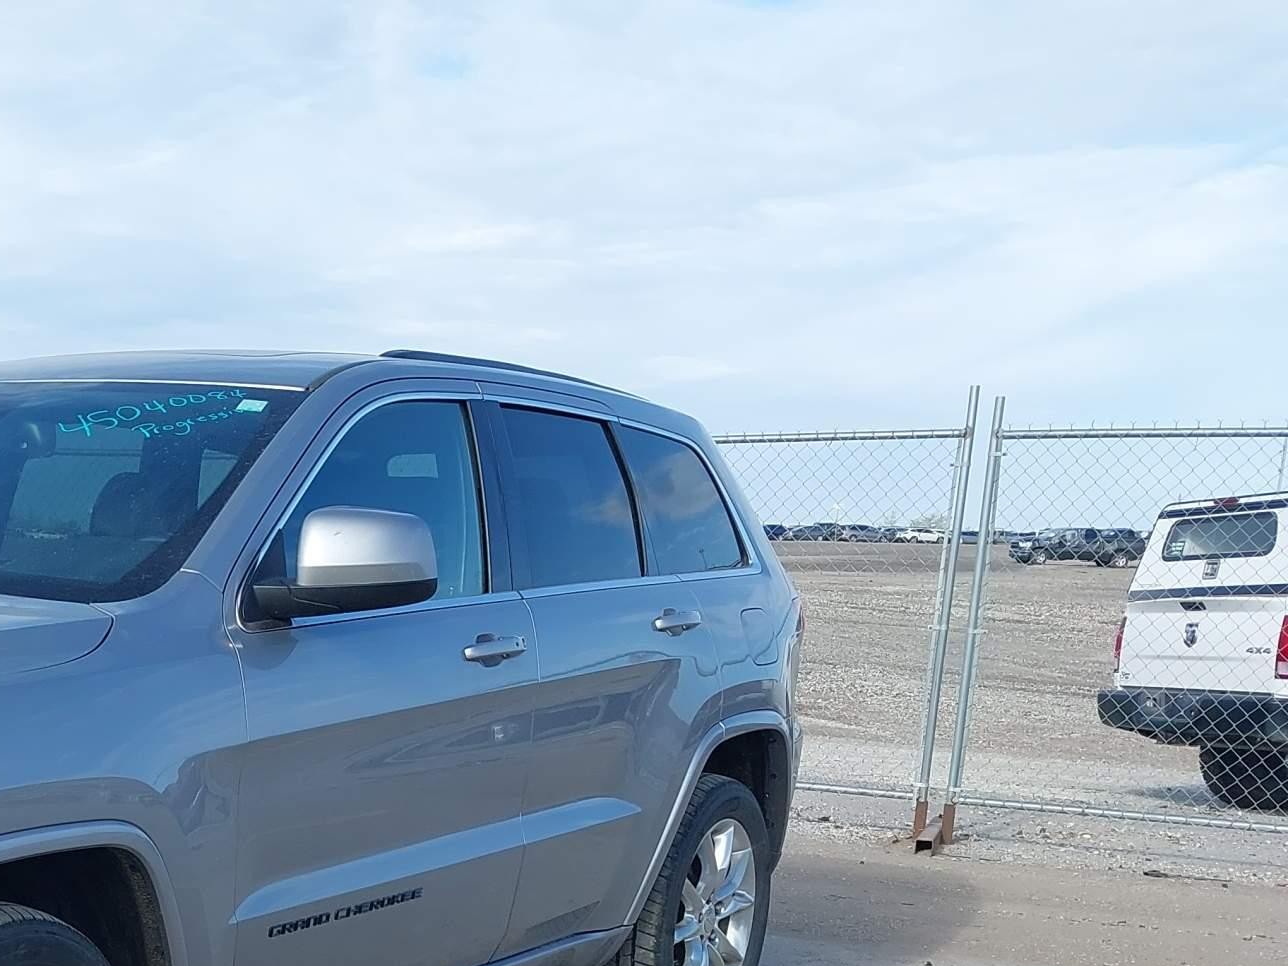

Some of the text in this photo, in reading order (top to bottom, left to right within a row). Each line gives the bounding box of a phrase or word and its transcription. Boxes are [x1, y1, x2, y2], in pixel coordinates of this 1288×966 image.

[59, 389, 247, 437] 45040084
[268, 887, 424, 938] GRAND CHEROKEE
